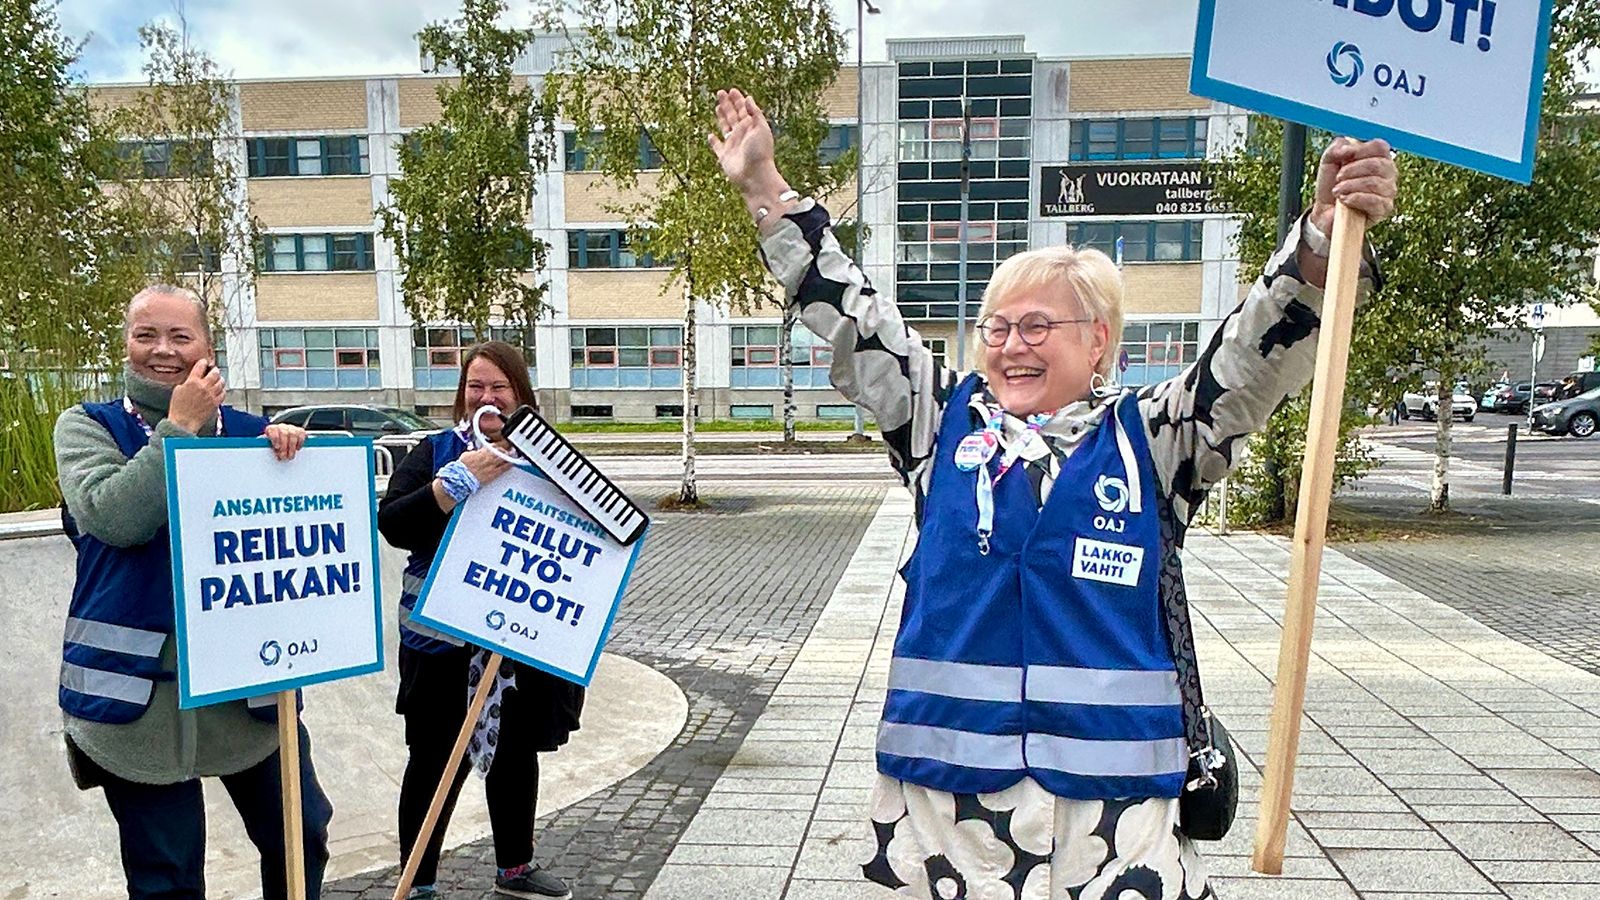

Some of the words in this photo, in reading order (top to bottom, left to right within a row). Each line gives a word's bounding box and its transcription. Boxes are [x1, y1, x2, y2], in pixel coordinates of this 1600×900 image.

[1373, 63, 1427, 97] OAJ
[1096, 171, 1201, 187] VUOKRATAAN
[1045, 203, 1095, 213] TALLBERG
[1156, 203, 1178, 213] 040
[1180, 202, 1202, 213] 825
[213, 494, 343, 517] ANSAITSEMME
[502, 488, 606, 539] ANSAITSEMME
[1093, 516, 1125, 533] OAJ
[214, 522, 346, 565] REILUN
[491, 506, 602, 567] REILUT
[500, 541, 572, 583] TYÖ-
[1082, 545, 1138, 564] LAKKO-
[1081, 560, 1125, 578] VAHTI
[200, 562, 361, 611] PALKAN!
[463, 561, 585, 627] EHDOT!
[510, 623, 539, 641] OAJ
[287, 639, 318, 656] OAJ
